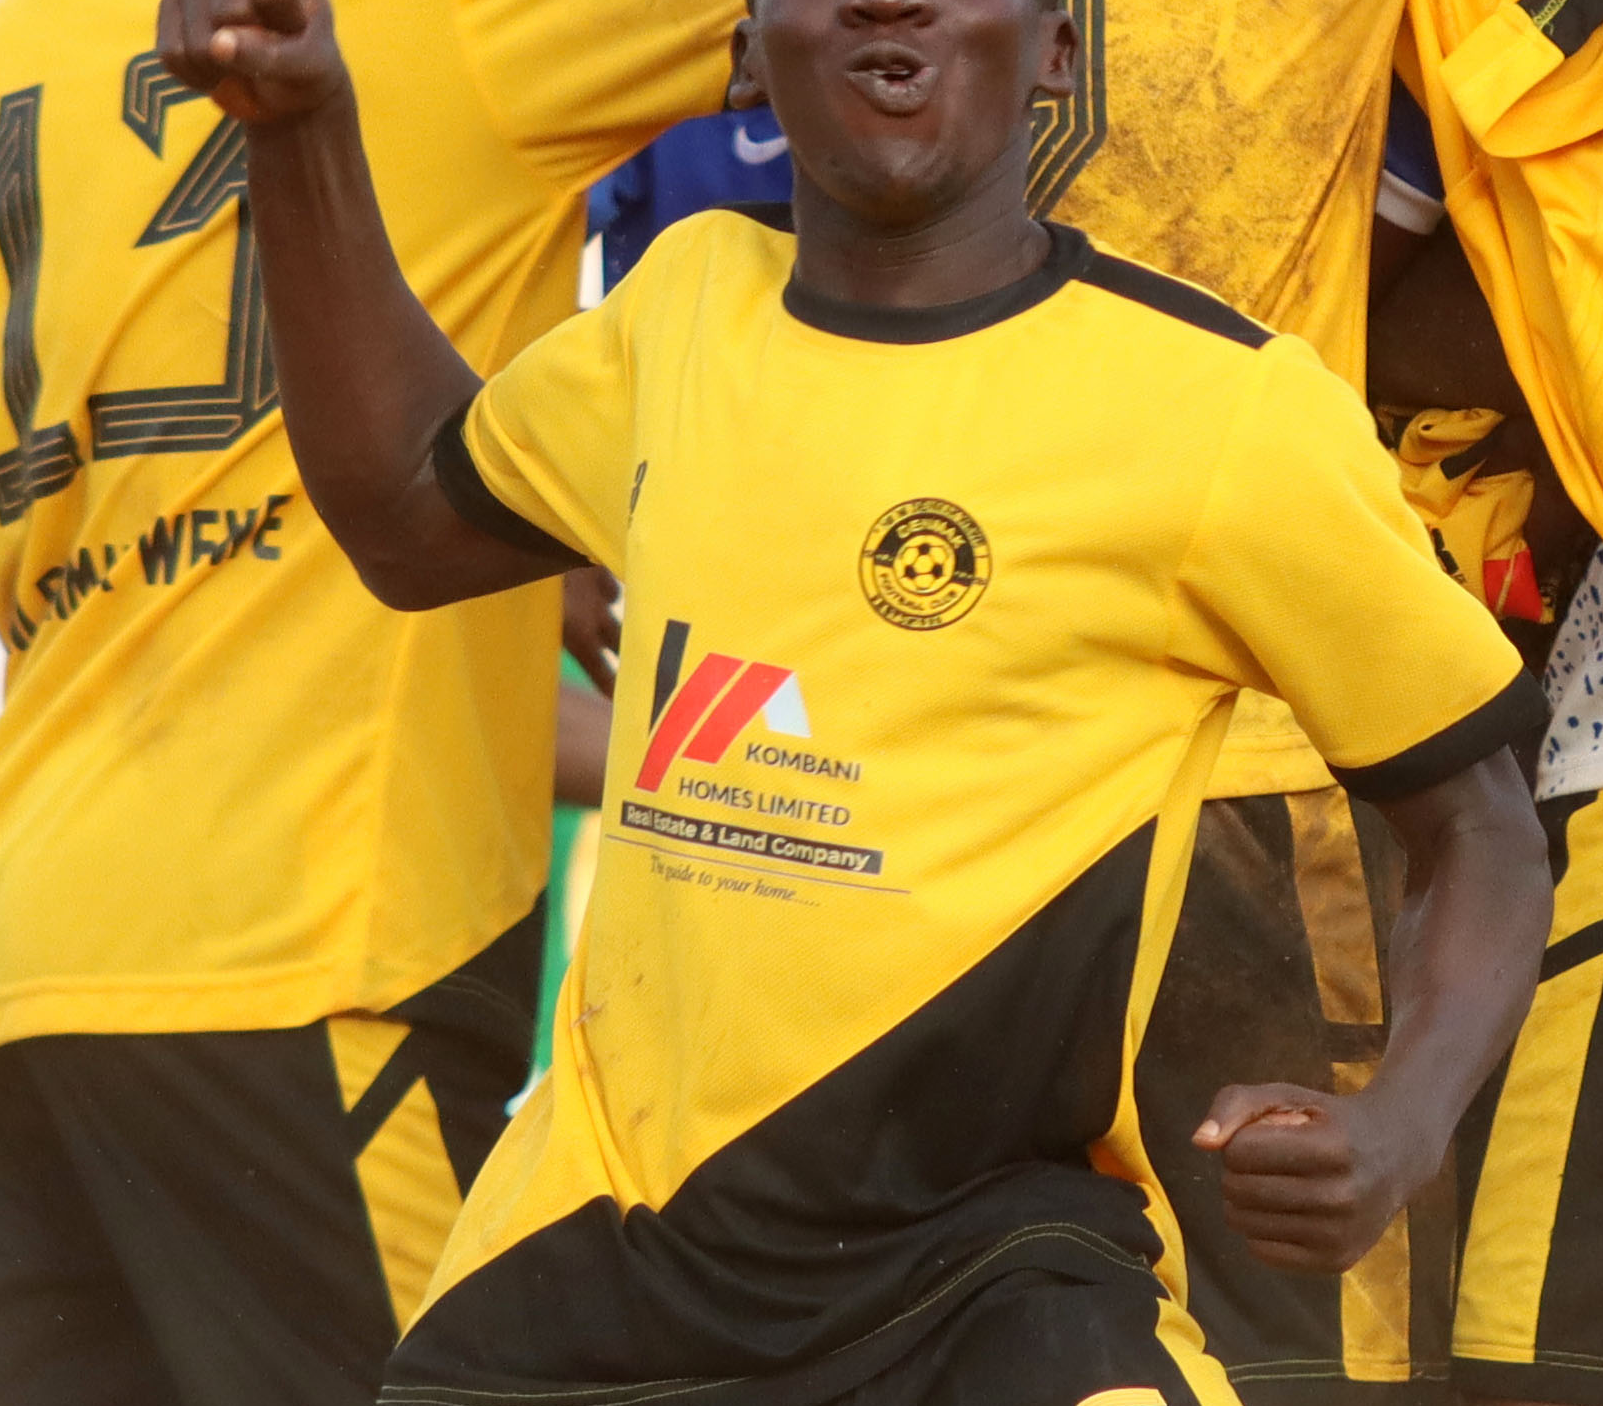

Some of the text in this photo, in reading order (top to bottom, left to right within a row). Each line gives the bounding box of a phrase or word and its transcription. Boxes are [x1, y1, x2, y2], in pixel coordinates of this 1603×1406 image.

[745, 743, 862, 782] KOMBANI
[678, 777, 851, 827] HOMES LIMITED
[626, 805, 871, 871] Real Estate & Land Company
[697, 870, 714, 886] to
[715, 876, 752, 894] your
